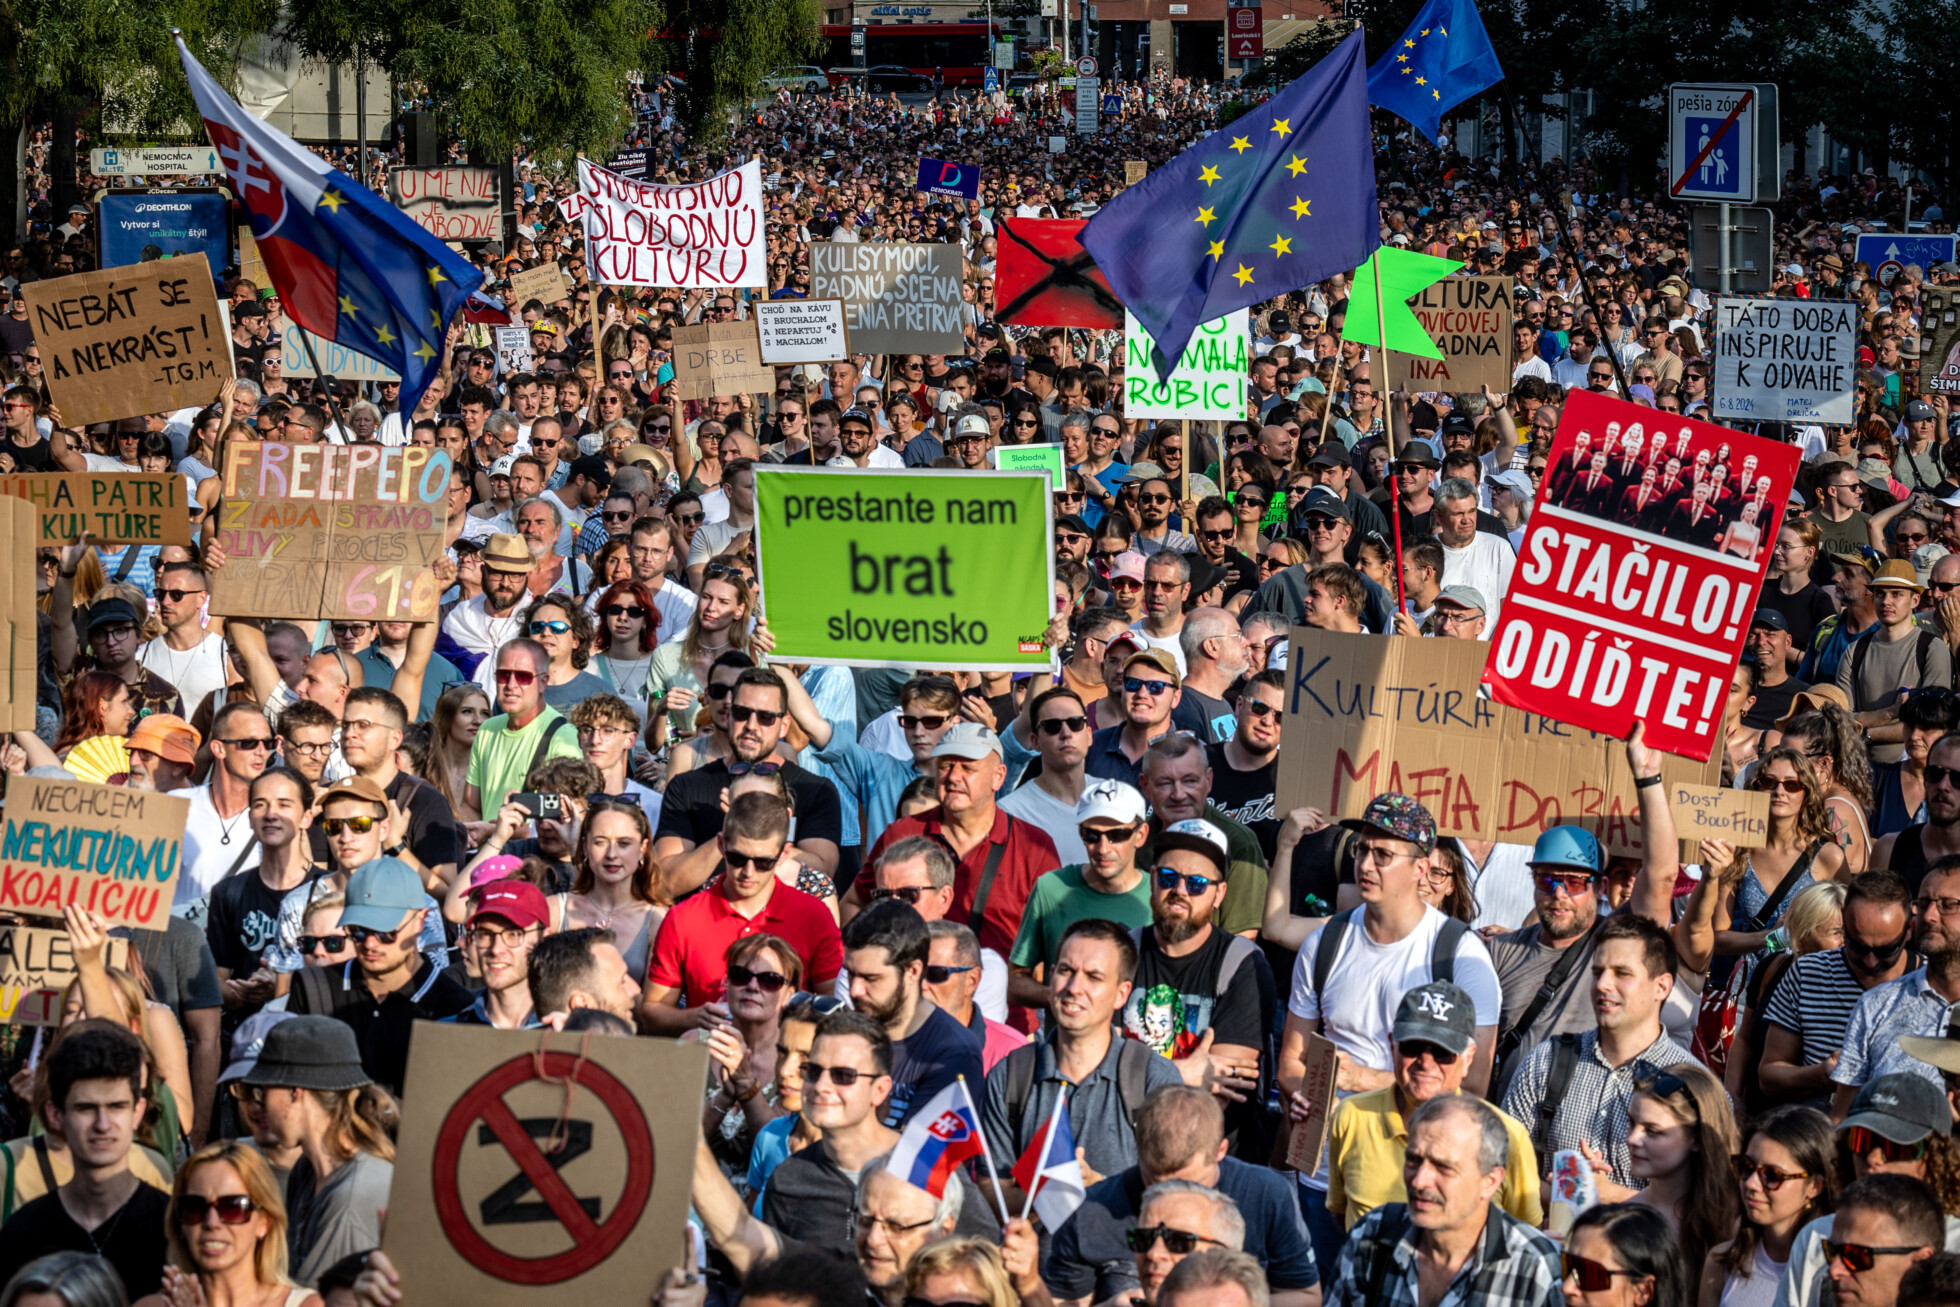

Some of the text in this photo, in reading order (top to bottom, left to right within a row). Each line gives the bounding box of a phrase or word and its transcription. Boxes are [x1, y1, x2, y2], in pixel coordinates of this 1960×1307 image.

[872, 5, 933, 18] eiffel optic
[1678, 94, 1747, 114] pešia zóna
[142, 153, 193, 161] NEMOCNICA
[400, 168, 493, 199] UMENIE
[930, 186, 963, 196] DEMOKRATI
[421, 200, 443, 217] JE
[560, 194, 594, 219] ZA
[120, 220, 160, 230] Vytvor si
[149, 229, 208, 238] unikátny štýl!
[405, 208, 500, 239] OBODNÉ
[590, 204, 756, 249] SLOBODNÚ
[592, 242, 746, 285] KULTÚRU
[1404, 277, 1511, 310] ULTÚRA
[36, 279, 191, 336] NEBÁT SE
[761, 304, 784, 314] CHOĎ
[808, 303, 832, 312] KÁVU
[774, 316, 828, 324] BRUCHALOM
[846, 303, 890, 330] ENIA
[1793, 308, 1852, 333] DOBA
[776, 327, 822, 336] NEPAKTUJ
[776, 337, 828, 346] MACHALOM!
[688, 348, 746, 369] DRBE
[1129, 335, 1248, 374] NMALA
[1721, 330, 1838, 362] INŠPIRUJE
[54, 354, 70, 380] A
[1736, 360, 1751, 387] K
[1949, 366, 1960, 375] D
[1930, 376, 1960, 391] ŠIM
[1126, 376, 1246, 419] ROBIC!
[1719, 398, 1754, 412] 6.8.2024
[1786, 398, 1812, 406] MATEJ
[1012, 454, 1046, 462] Slobodná
[3, 475, 178, 508] ÚHA PATRÍ
[784, 491, 1017, 527] prestante nam
[42, 508, 161, 540] KULTÚRE
[312, 531, 408, 562] PROCES
[849, 540, 954, 597] brat
[345, 564, 442, 619] 61:0
[1522, 526, 1752, 642] STAČILO!
[828, 609, 988, 645] slovensko
[1020, 644, 1042, 652] SASKA
[1290, 646, 1496, 730] KULTÚRA
[1496, 619, 1723, 736] ODÍĎTE!
[31, 786, 145, 820] NECHCEM
[1677, 790, 1724, 808] DOSŤ
[1498, 780, 1562, 833] DO
[1571, 780, 1643, 849] BAS
[1694, 809, 1766, 835] BOLO FICA
[1, 818, 178, 882] NEKULTÚRNU
[0, 864, 160, 924] KOALÍCIU
[1418, 992, 1454, 1022] NY
